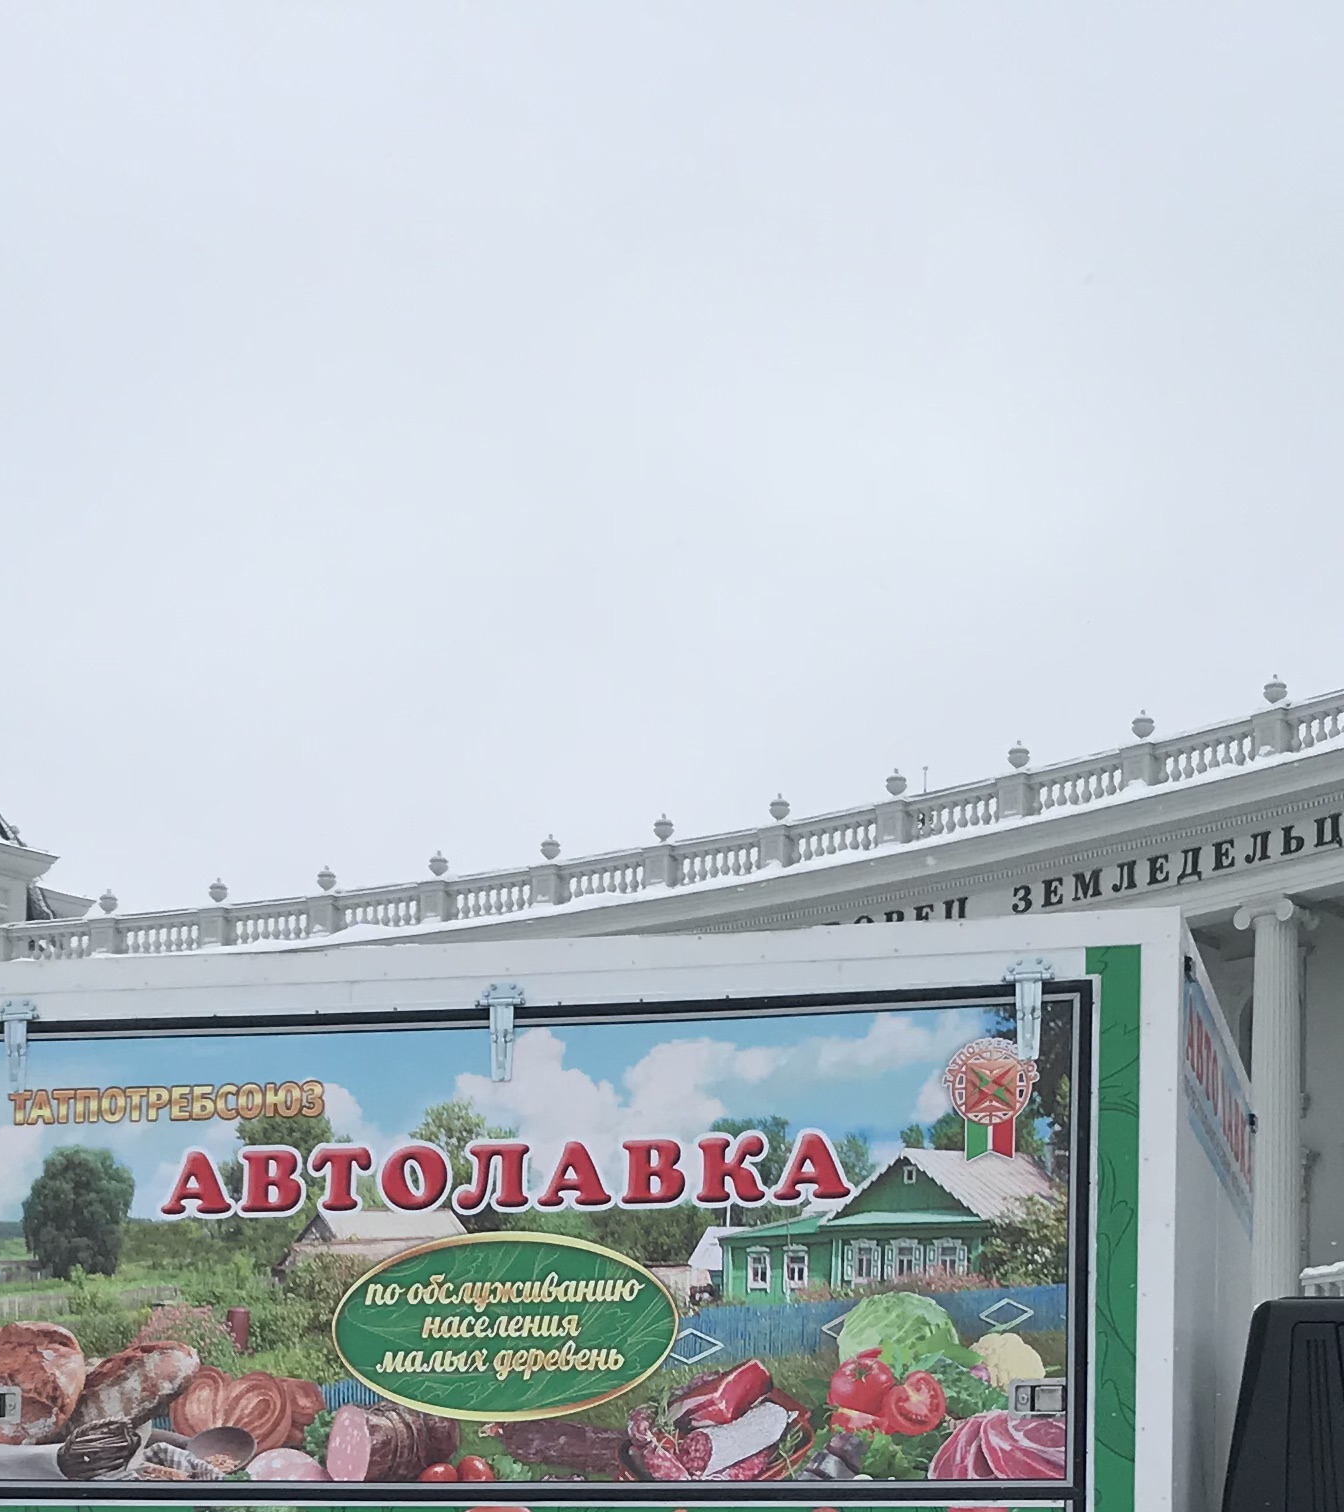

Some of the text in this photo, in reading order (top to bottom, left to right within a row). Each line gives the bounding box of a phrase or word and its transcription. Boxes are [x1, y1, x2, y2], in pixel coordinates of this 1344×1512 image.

[9, 1080, 325, 1125] ТАТПОТРЕБСОЮЗ
[160, 1132, 851, 1215] АВТОЛАВКА
[365, 1272, 645, 1312] по обслуживанию
[422, 1314, 581, 1338] населения
[375, 1340, 624, 1381] малых деревень
